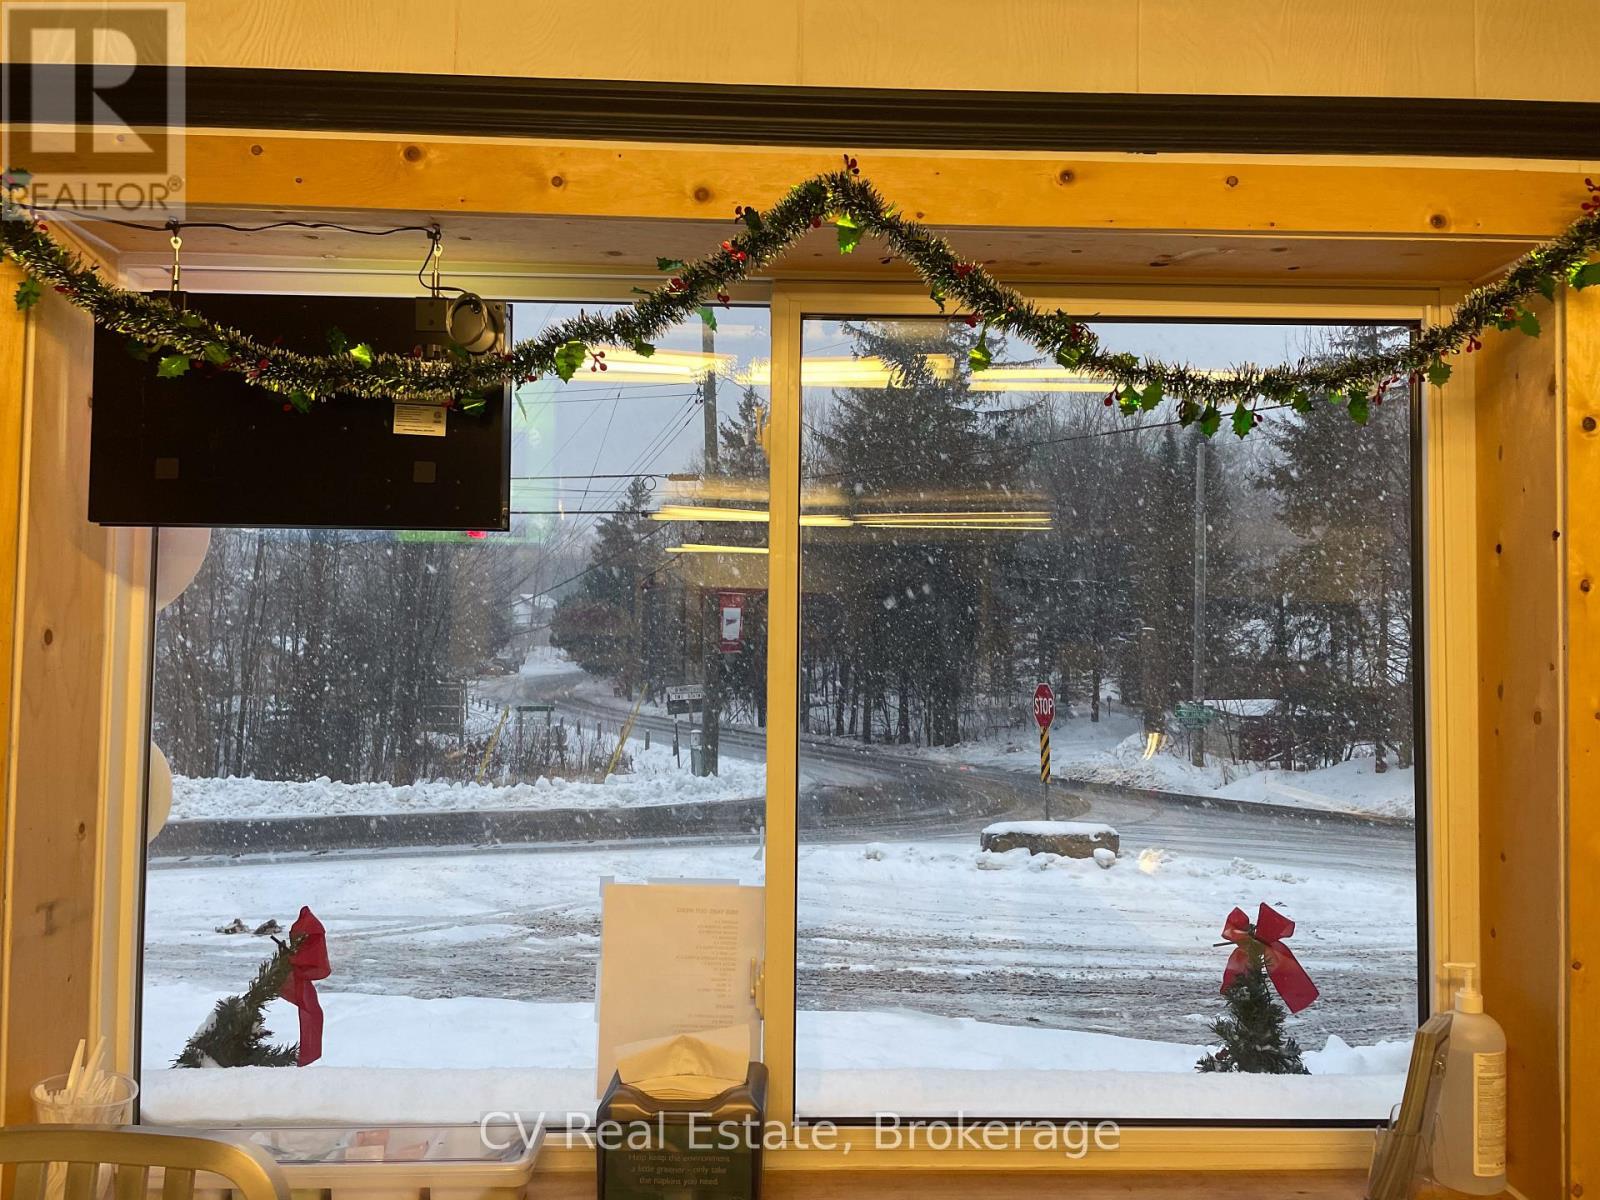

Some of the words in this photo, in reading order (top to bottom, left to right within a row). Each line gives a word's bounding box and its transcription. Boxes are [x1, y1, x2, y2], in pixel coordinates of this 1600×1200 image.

[1035, 697, 1053, 715] STOP
[628, 1153, 647, 1162] Help
[649, 1153, 667, 1162] keep
[669, 1153, 681, 1161] the
[683, 1154, 730, 1162] environment
[638, 1165, 654, 1173] little
[656, 1167, 685, 1175] greener
[693, 1165, 708, 1175] only
[711, 1165, 728, 1173] take
[653, 1176, 681, 1186] napkins
[683, 1178, 698, 1187] you
